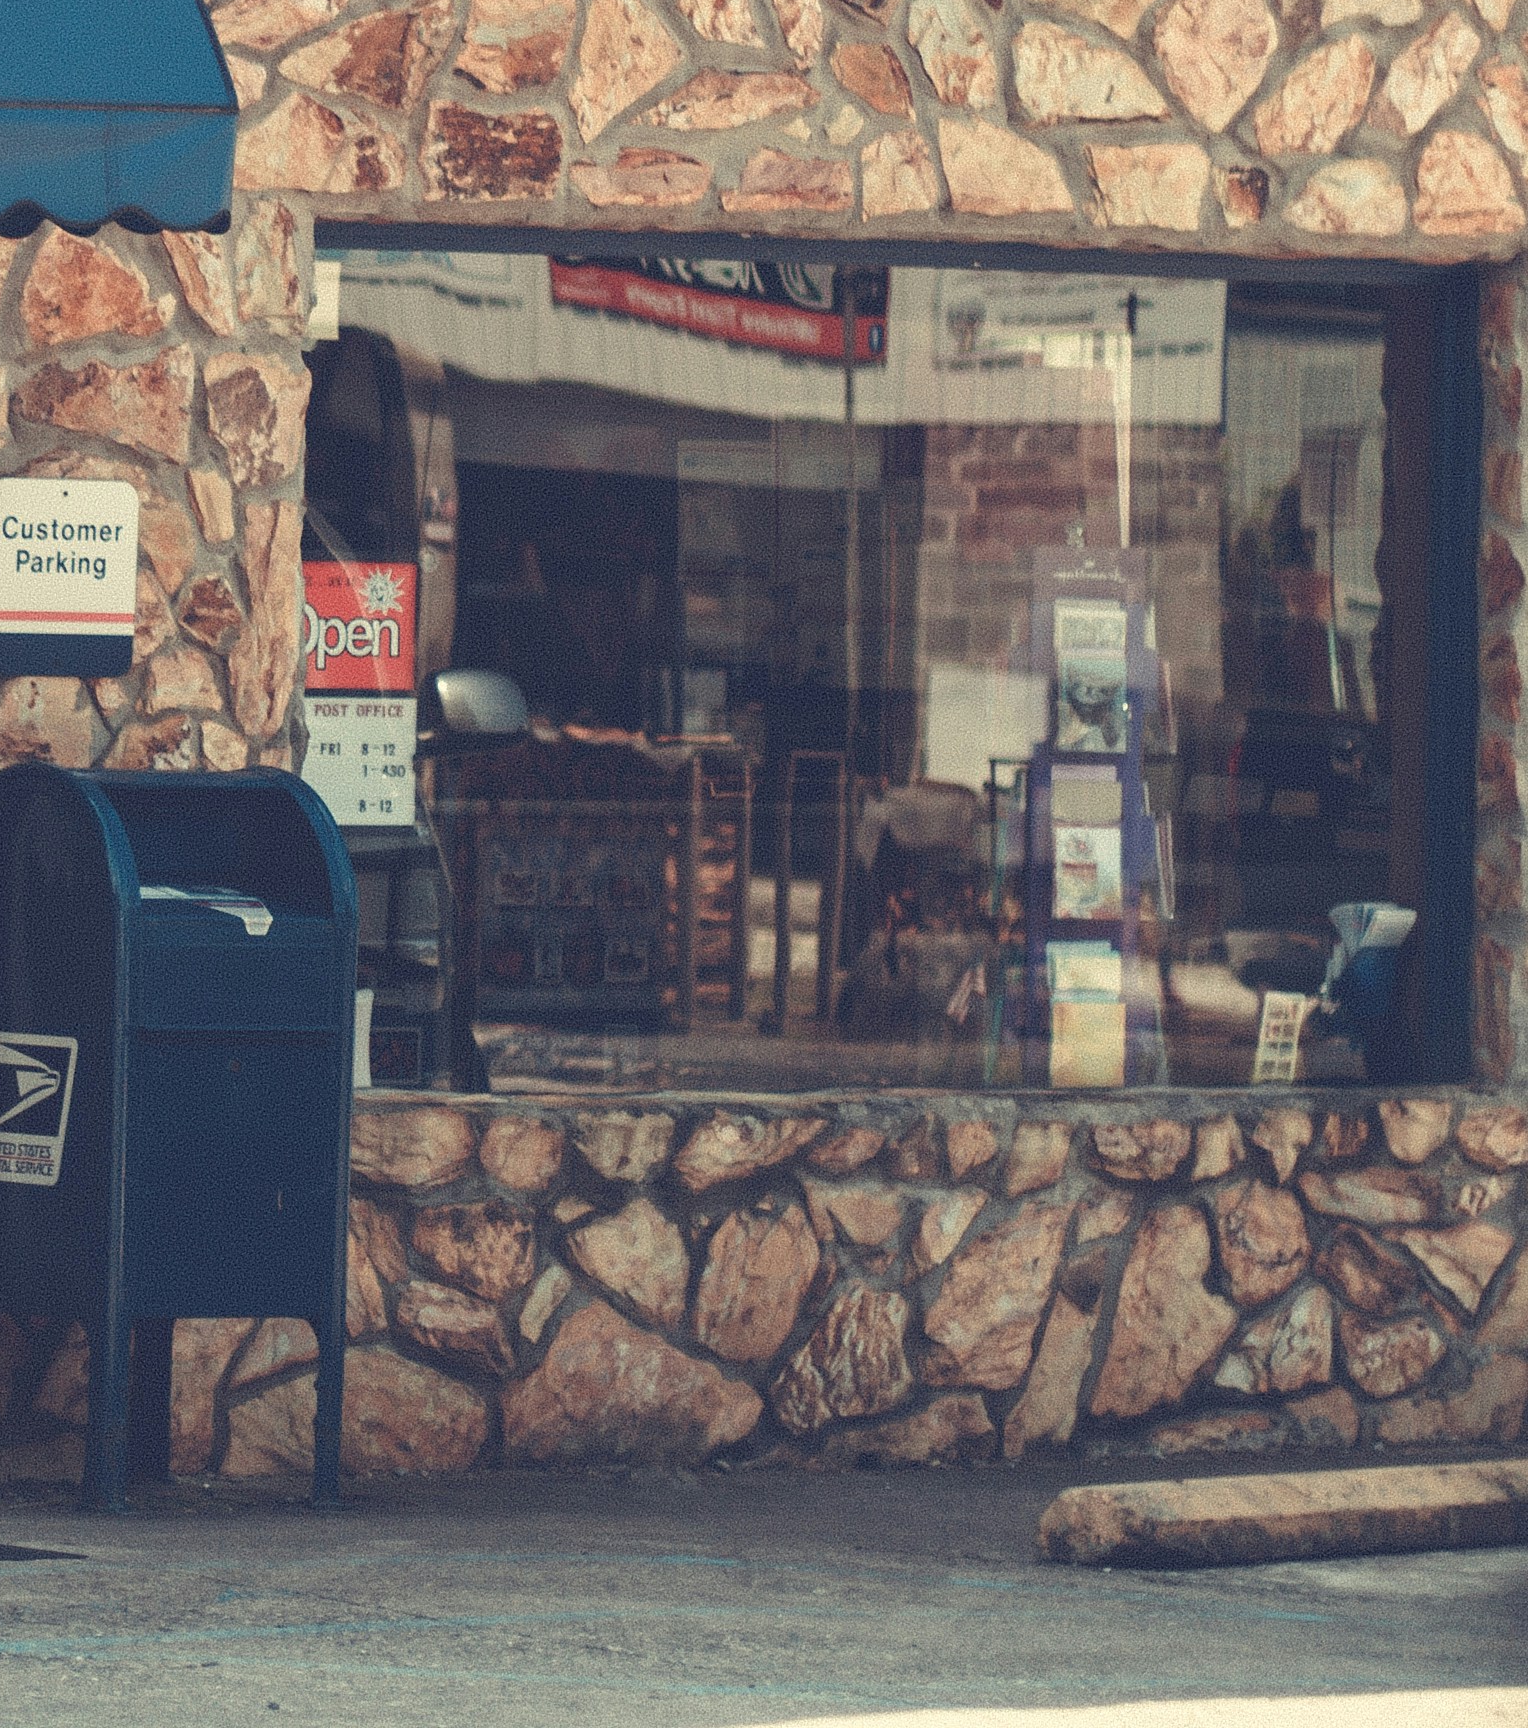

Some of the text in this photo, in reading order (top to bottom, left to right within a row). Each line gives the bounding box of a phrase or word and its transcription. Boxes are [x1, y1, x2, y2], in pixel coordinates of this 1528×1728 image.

[1, 515, 124, 542] Customer
[15, 548, 107, 580] Parking
[314, 704, 404, 718] POST OFFICE
[17, 1143, 53, 1159] STATES
[15, 1160, 55, 1177] SERVICE
